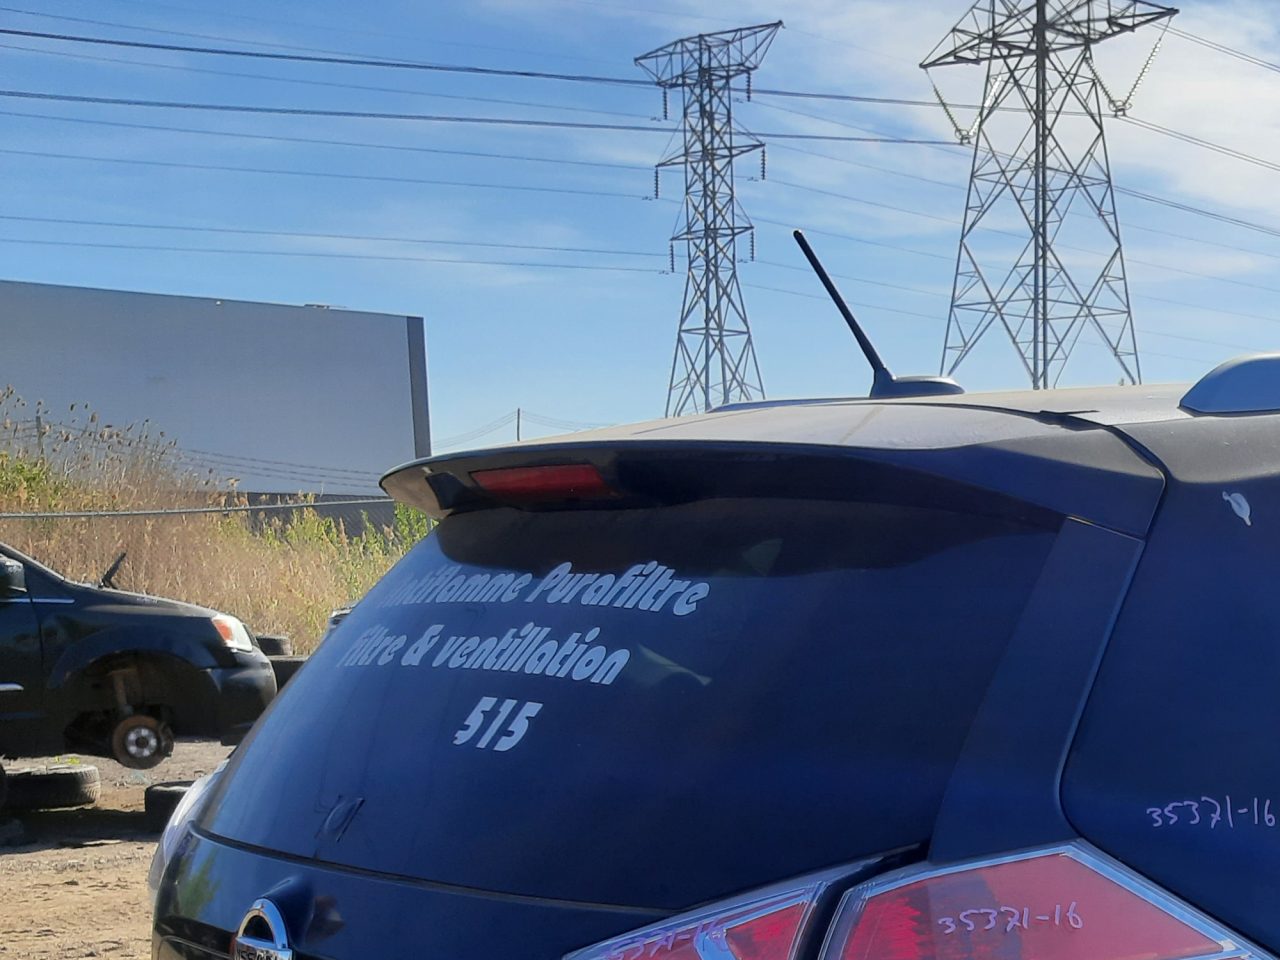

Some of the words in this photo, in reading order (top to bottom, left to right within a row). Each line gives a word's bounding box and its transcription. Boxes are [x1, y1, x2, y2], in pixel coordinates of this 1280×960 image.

[378, 564, 534, 609] ntiflamme
[526, 561, 711, 616] Purafiltre
[401, 624, 445, 667] &
[433, 622, 631, 685] ventillation
[453, 696, 544, 752] 515
[1146, 795, 1276, 828] 35371-16
[938, 901, 1083, 934] 35371-16
